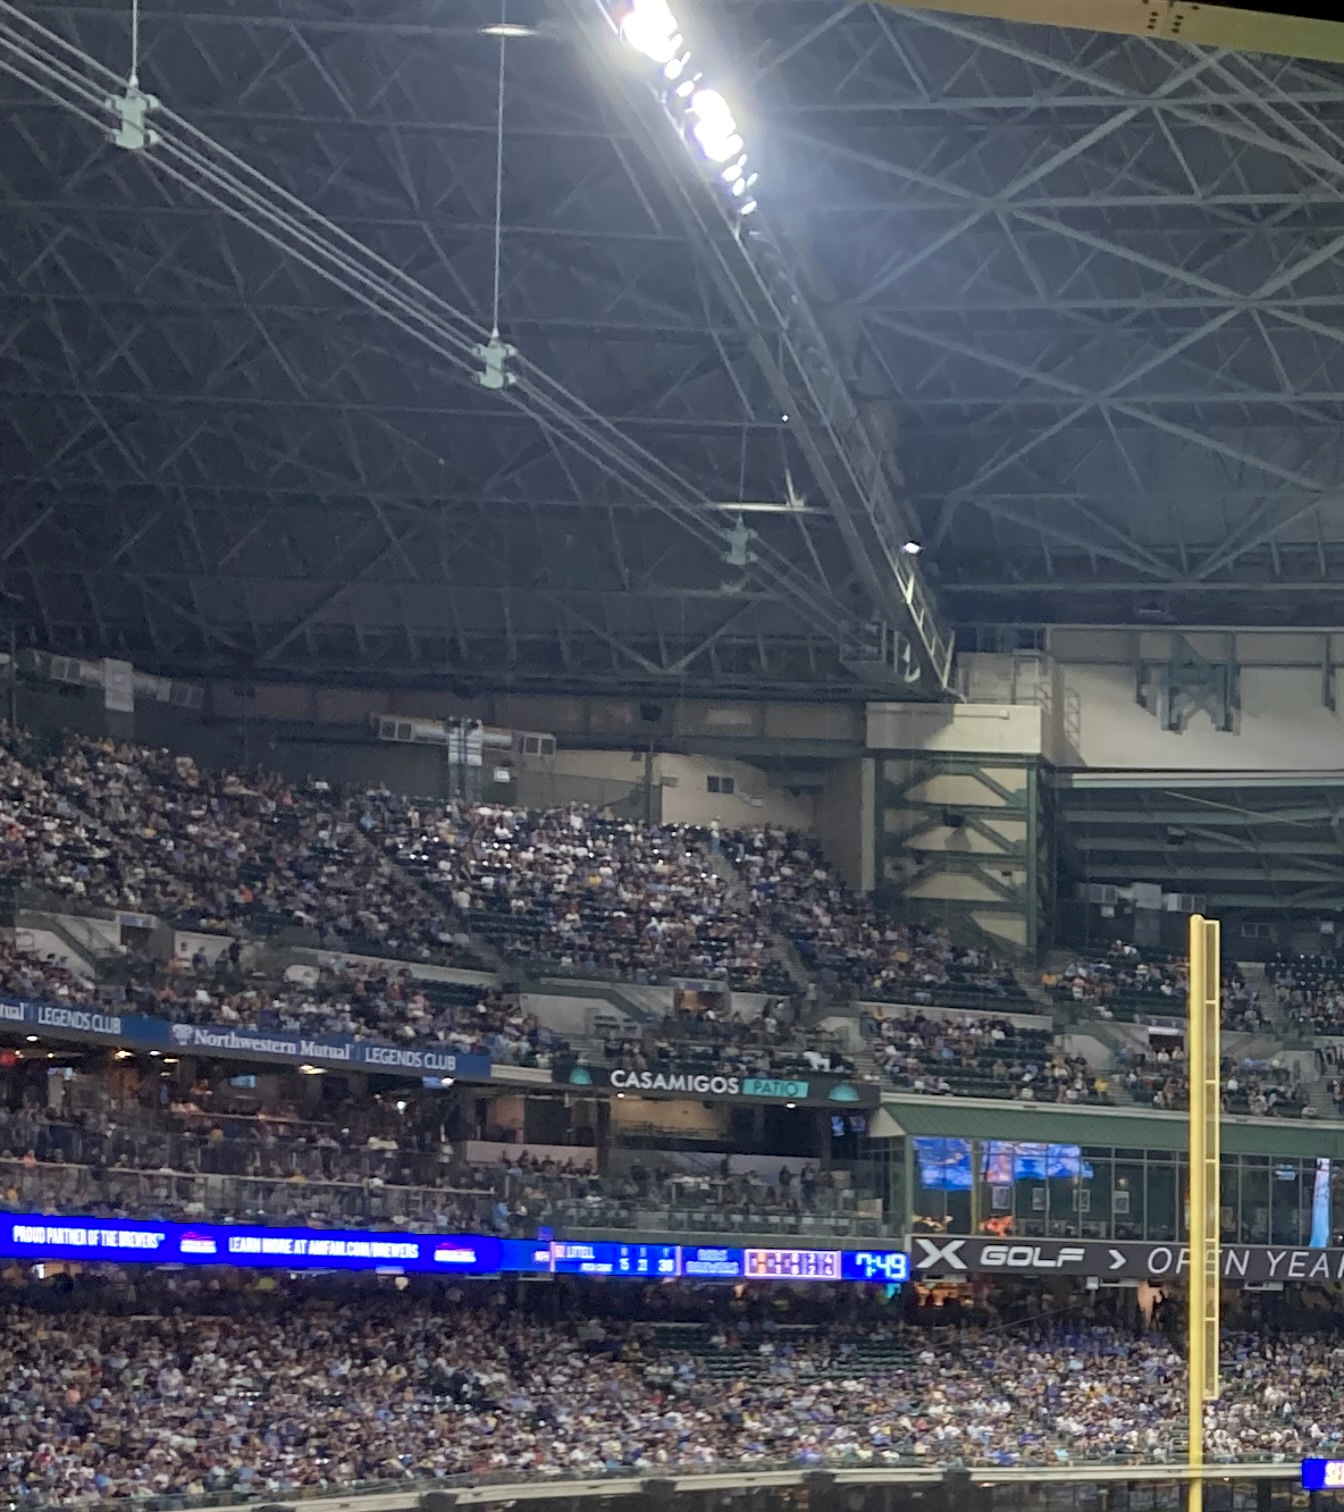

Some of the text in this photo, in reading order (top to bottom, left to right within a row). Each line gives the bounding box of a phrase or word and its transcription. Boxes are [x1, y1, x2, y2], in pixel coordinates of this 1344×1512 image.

[38, 1006, 90, 1032] LEGENDS
[92, 1014, 121, 1034] CLUB
[193, 1029, 456, 1071] Northwestern Mutual LEGENDS CLUB
[610, 1070, 799, 1097] CASAMIGOS PATIO
[855, 1253, 907, 1279] 7:49
[915, 1240, 967, 1269] X
[980, 1245, 1085, 1267] GOLF
